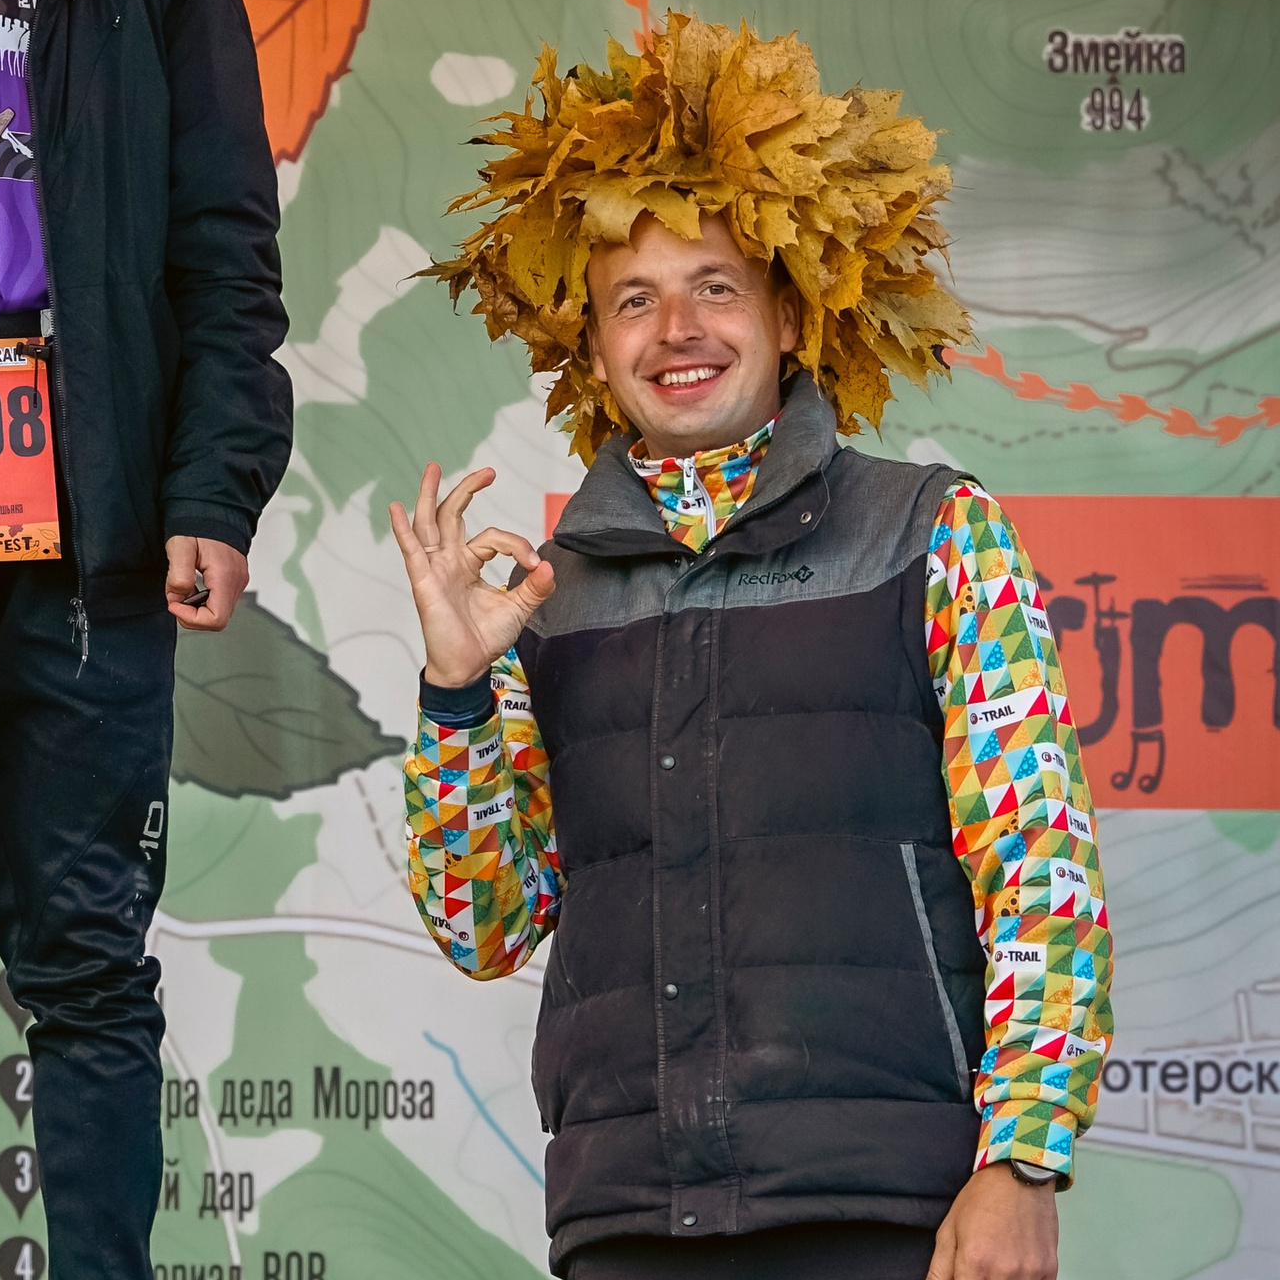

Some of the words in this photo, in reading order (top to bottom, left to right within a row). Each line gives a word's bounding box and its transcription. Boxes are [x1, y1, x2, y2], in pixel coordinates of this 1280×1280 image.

[1048, 30, 1187, 73] Змейка
[15, 1060, 33, 1101] 2
[220, 1078, 293, 1125] деда
[313, 1065, 435, 1131] Мороза
[1102, 1059, 1280, 1105] отерск
[15, 1151, 33, 1193] 3
[198, 1170, 256, 1223] дар
